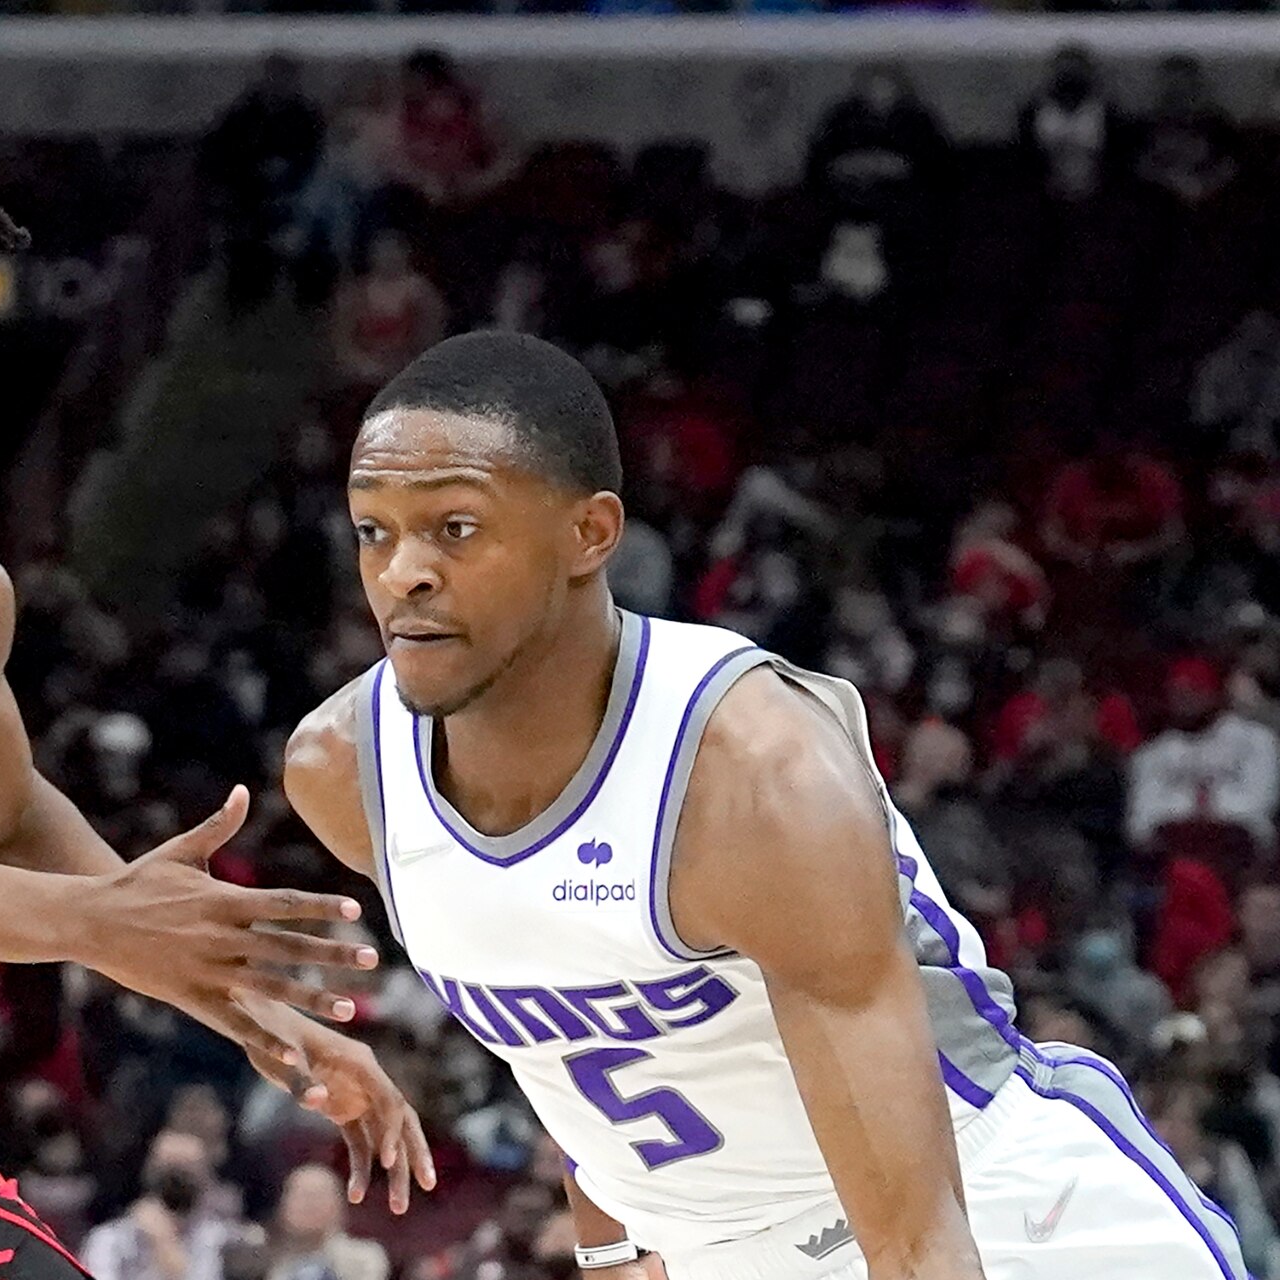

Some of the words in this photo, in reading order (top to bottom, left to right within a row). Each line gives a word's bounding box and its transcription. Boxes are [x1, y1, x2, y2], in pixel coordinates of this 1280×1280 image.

[552, 878, 635, 906] dialpad
[417, 963, 741, 1048] KINGS
[562, 1047, 725, 1172] 5
